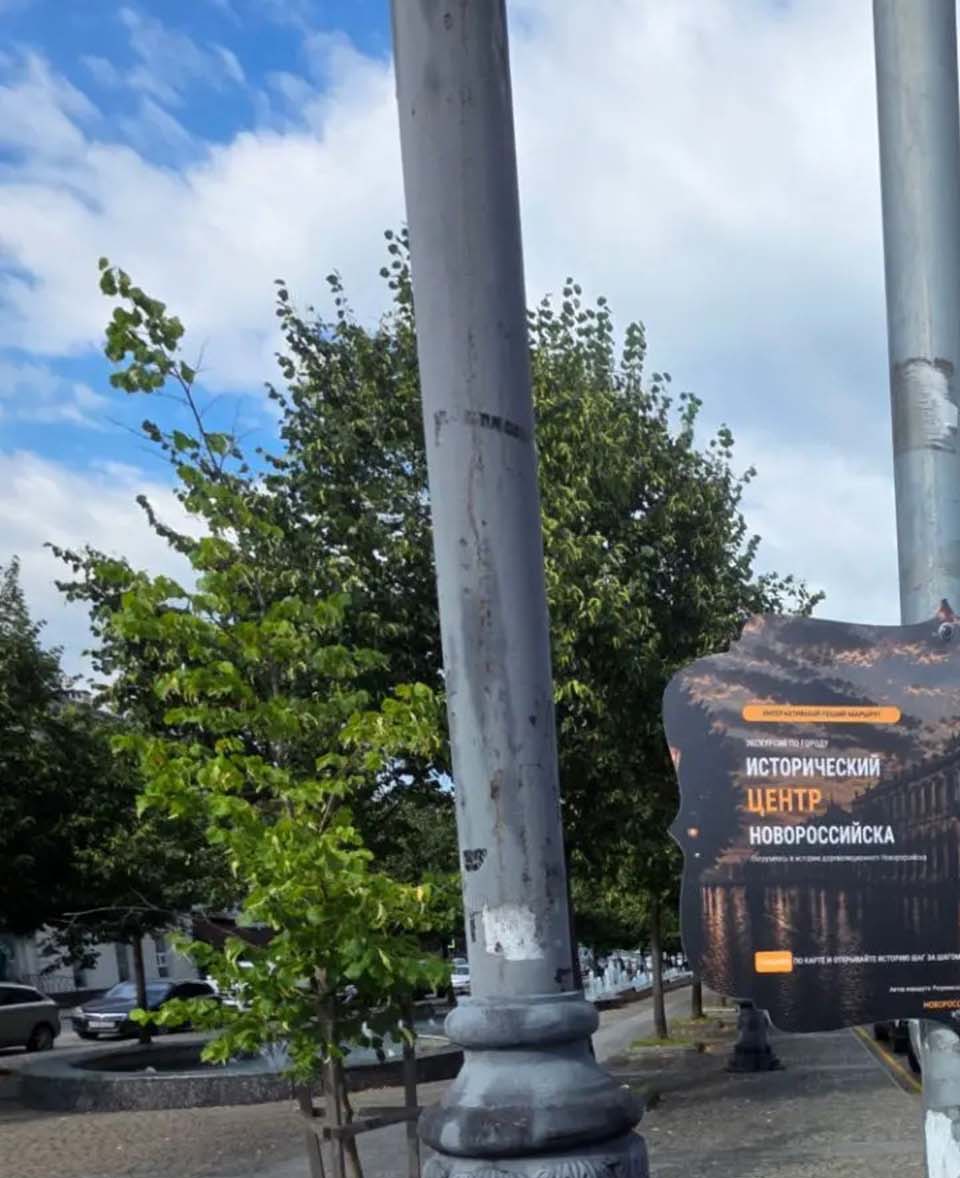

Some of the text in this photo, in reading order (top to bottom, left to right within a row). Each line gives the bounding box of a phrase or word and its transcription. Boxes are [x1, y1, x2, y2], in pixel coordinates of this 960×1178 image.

[746, 753, 880, 776] ИСТОРИЧЕСКИЙ
[747, 788, 822, 816] ЦЕНТР
[750, 821, 895, 844] НОВОРОССИЙСКА
